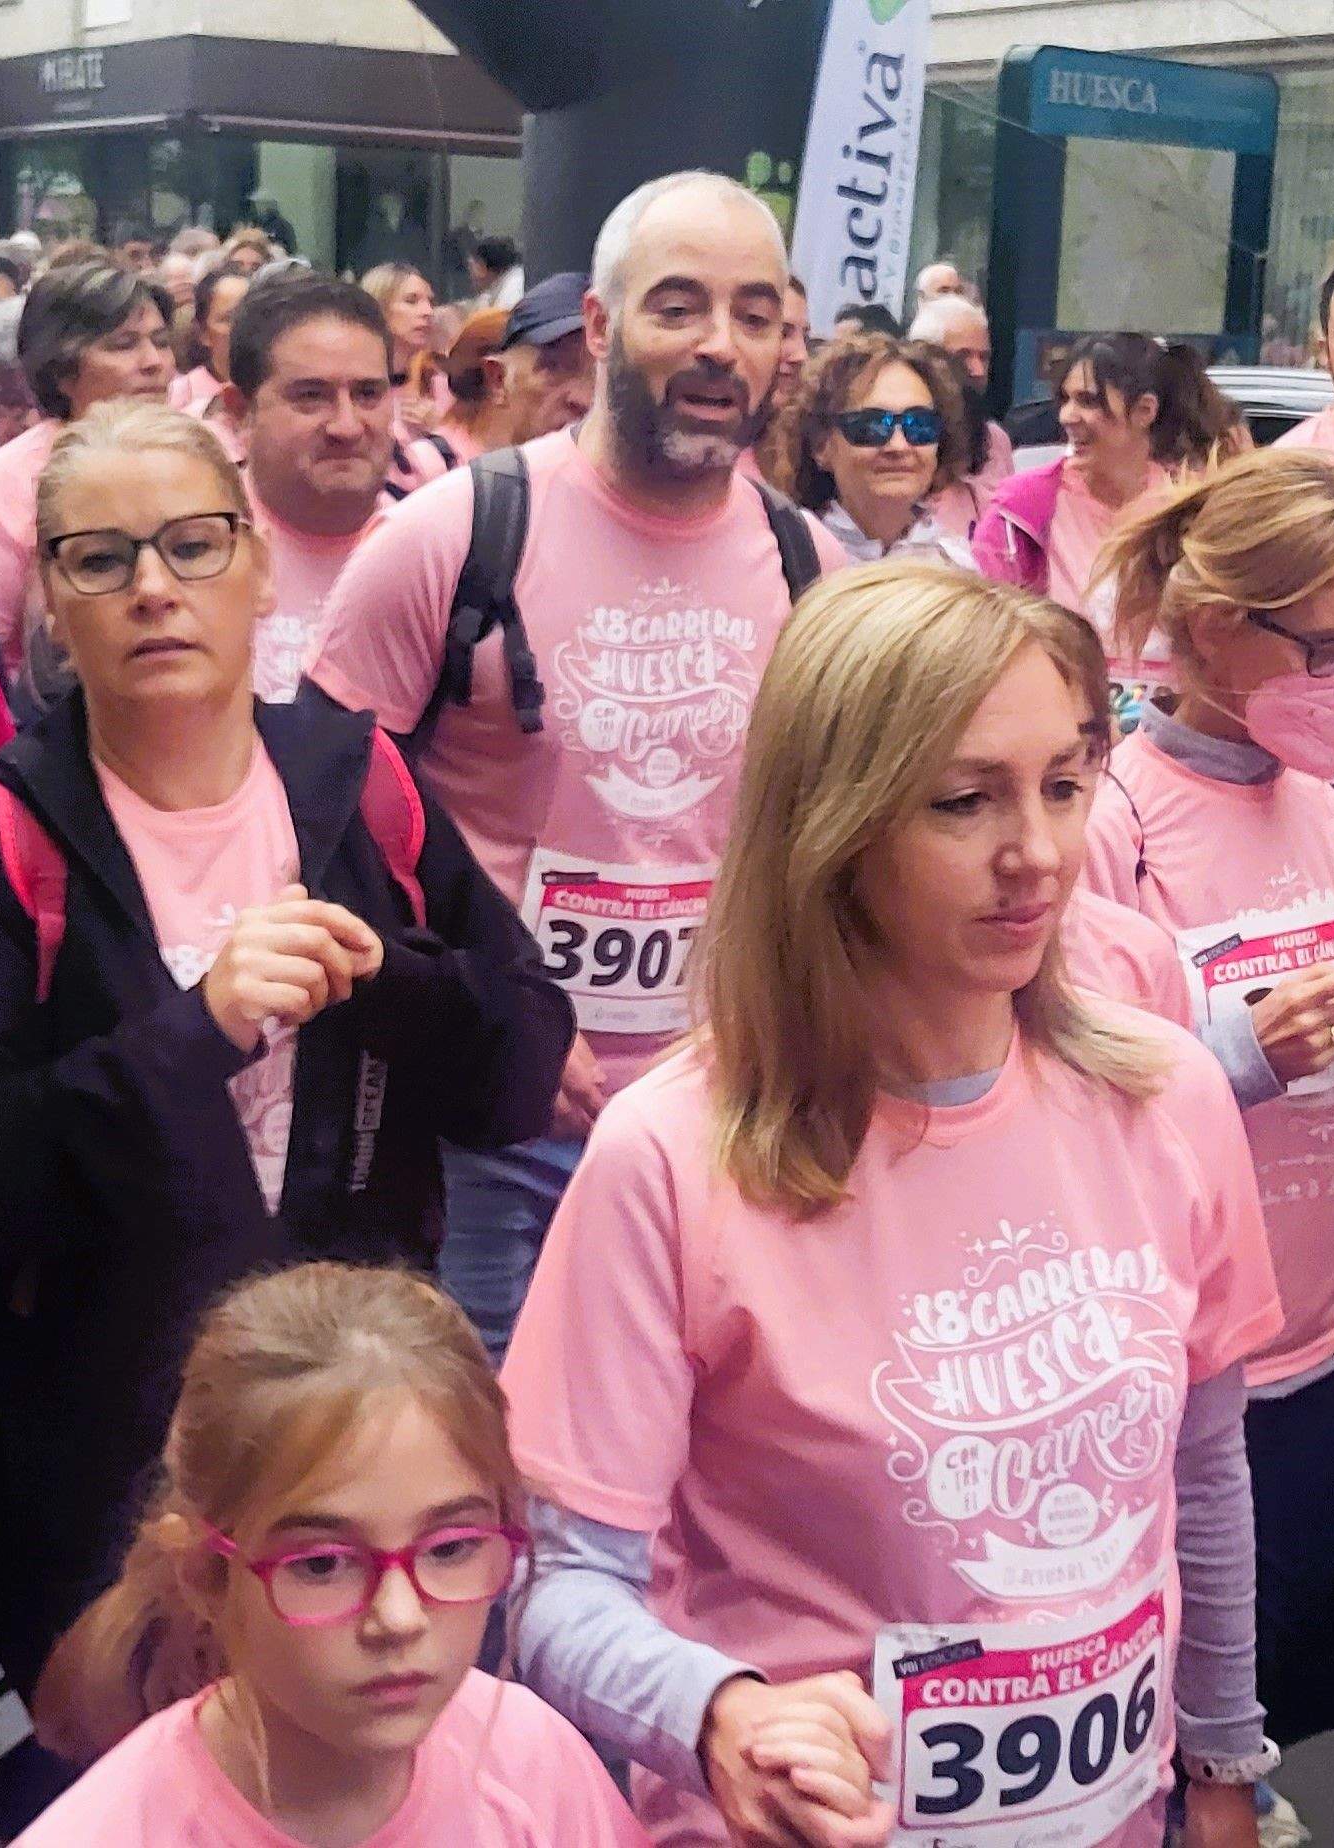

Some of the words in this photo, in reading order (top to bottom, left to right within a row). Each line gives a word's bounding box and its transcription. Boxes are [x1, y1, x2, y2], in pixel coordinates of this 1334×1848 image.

[1048, 68, 1158, 113] HUESCA
[594, 639, 717, 693] HUESCA
[554, 890, 634, 917] CONTRA
[1213, 952, 1293, 982] CONTRA
[1296, 948, 1310, 966] EL
[938, 1301, 1120, 1415] HUESCA
[1031, 1636, 1106, 1671] HUESCA
[922, 1675, 1050, 1705] CONTRA
[1058, 1666, 1086, 1692] EL
[916, 1652, 1156, 1815] 3906
